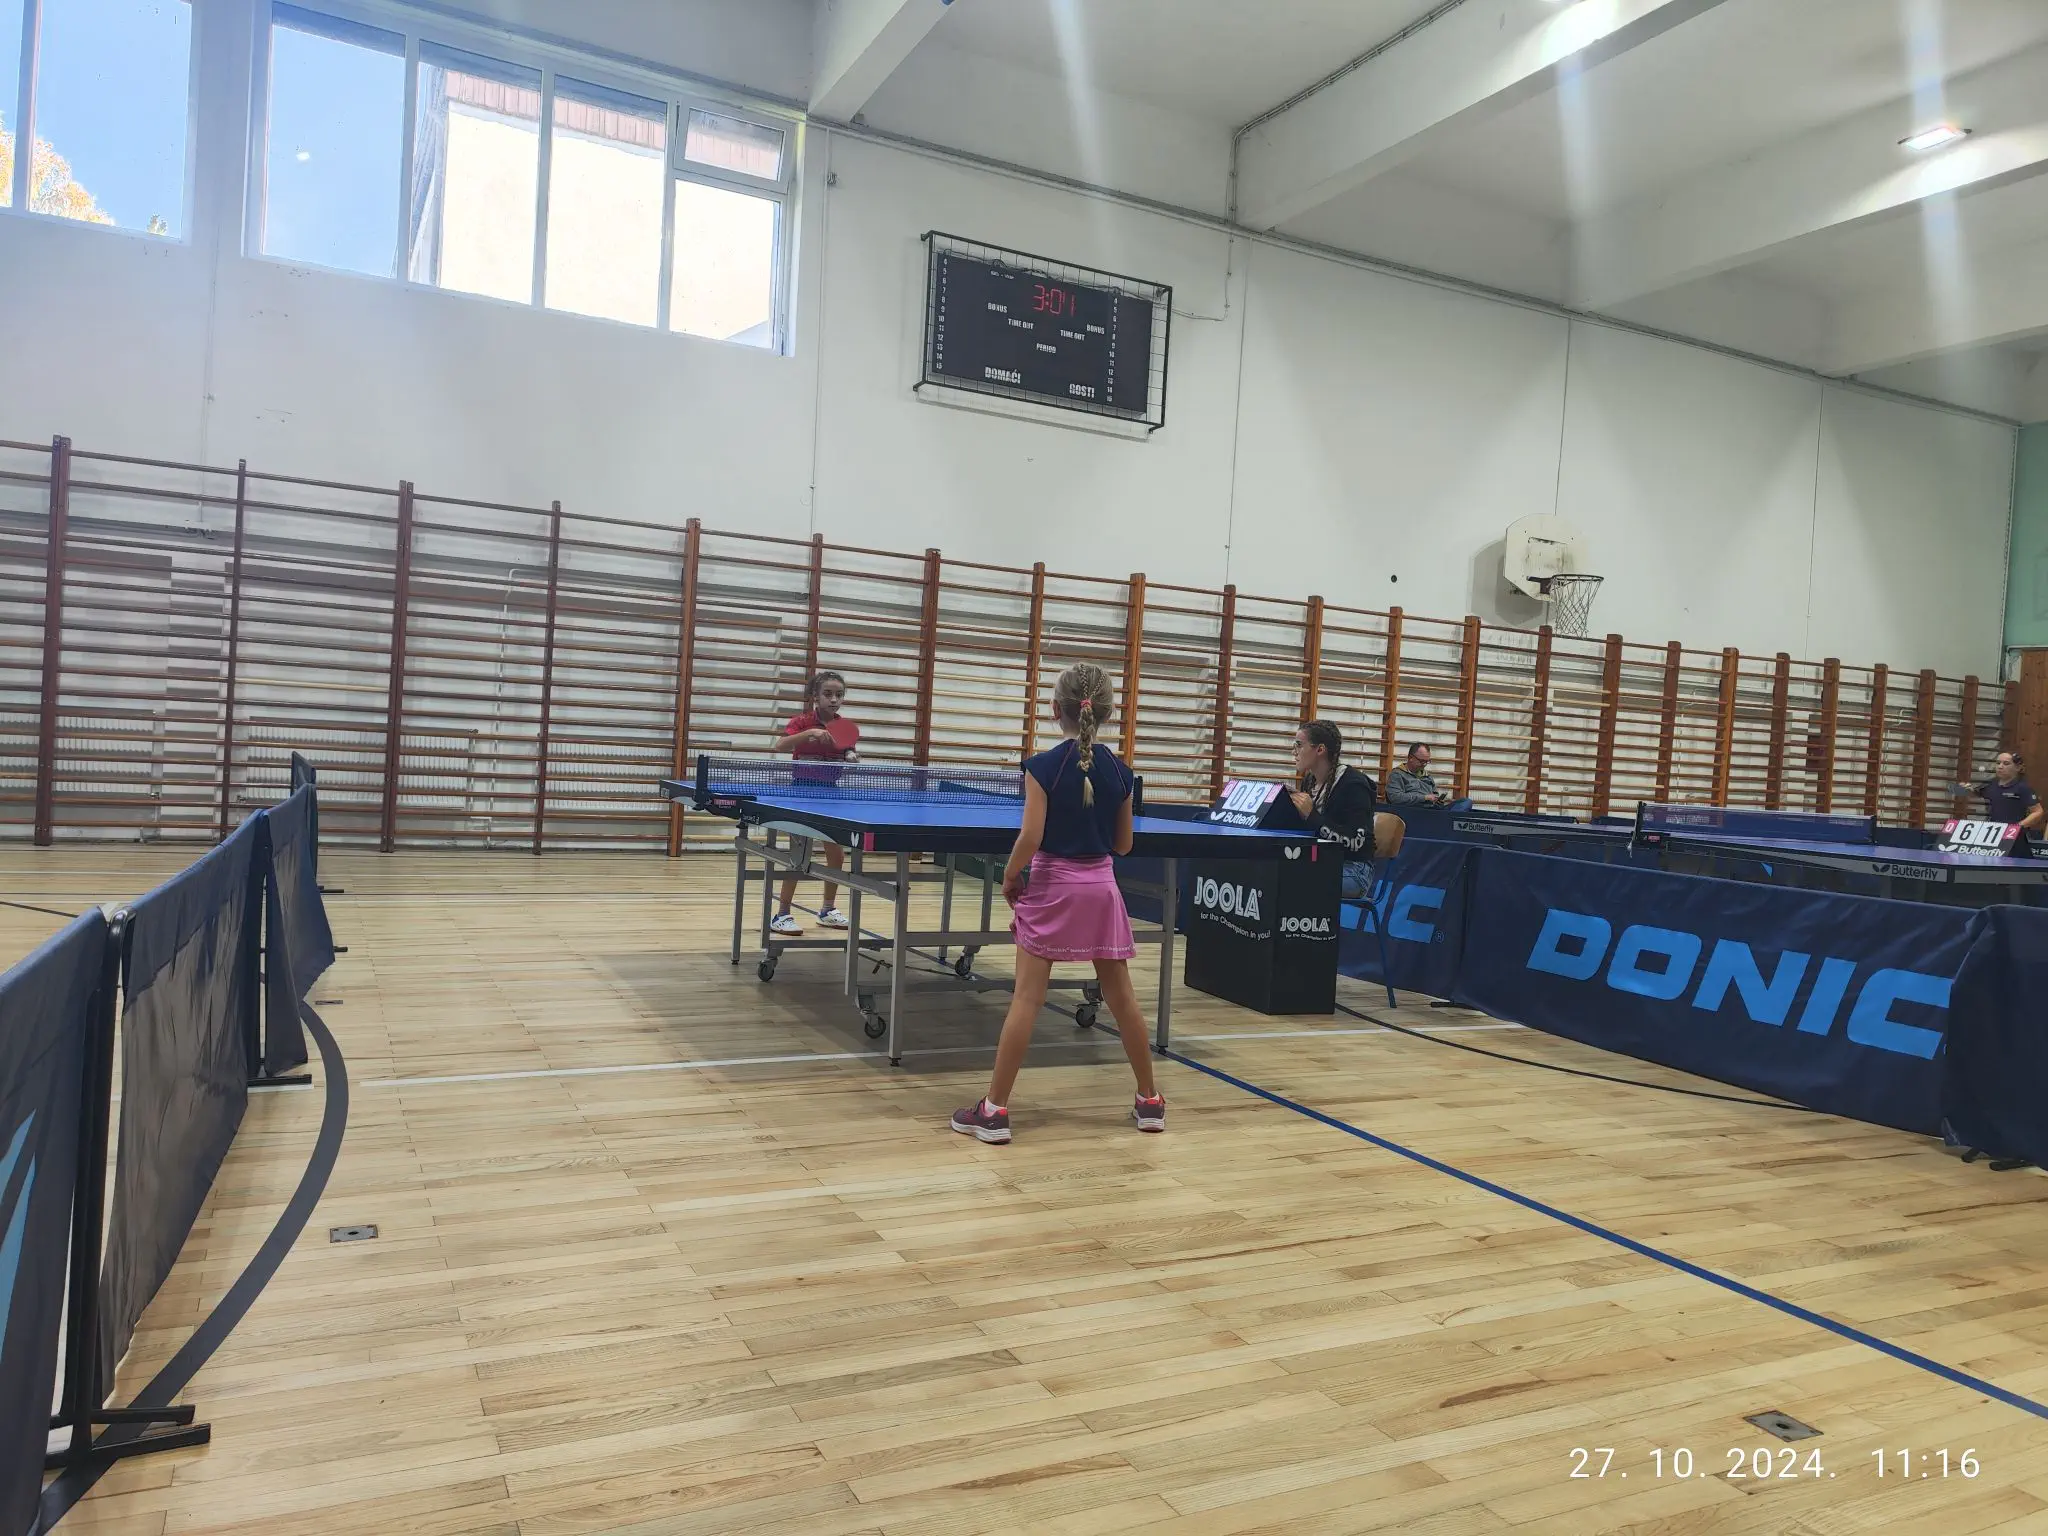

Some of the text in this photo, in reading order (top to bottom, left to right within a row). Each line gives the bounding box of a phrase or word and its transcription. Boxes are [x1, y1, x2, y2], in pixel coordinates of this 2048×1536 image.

[987, 302, 1008, 313] BONUS
[1008, 318, 1021, 327] TIME
[1086, 324, 1105, 335] BONUS
[1060, 329, 1074, 338] TIME
[1036, 342, 1057, 354] PERIOD
[984, 366, 1021, 384] DOMAĆI
[1069, 383, 1095, 398] GOSTI
[1248, 786, 1265, 809] 3
[1223, 811, 1259, 827] Butterfly
[1468, 823, 1494, 833] Butterfly
[1945, 822, 2016, 843] 0 6 11 2
[1958, 845, 2006, 857] Butterfly
[1891, 864, 1938, 881] Butterfly
[1200, 911, 1209, 920] for
[1210, 912, 1219, 922] the
[1220, 916, 1249, 938] Champion
[1250, 930, 1257, 939] in
[1526, 908, 1953, 1061] DONIC
